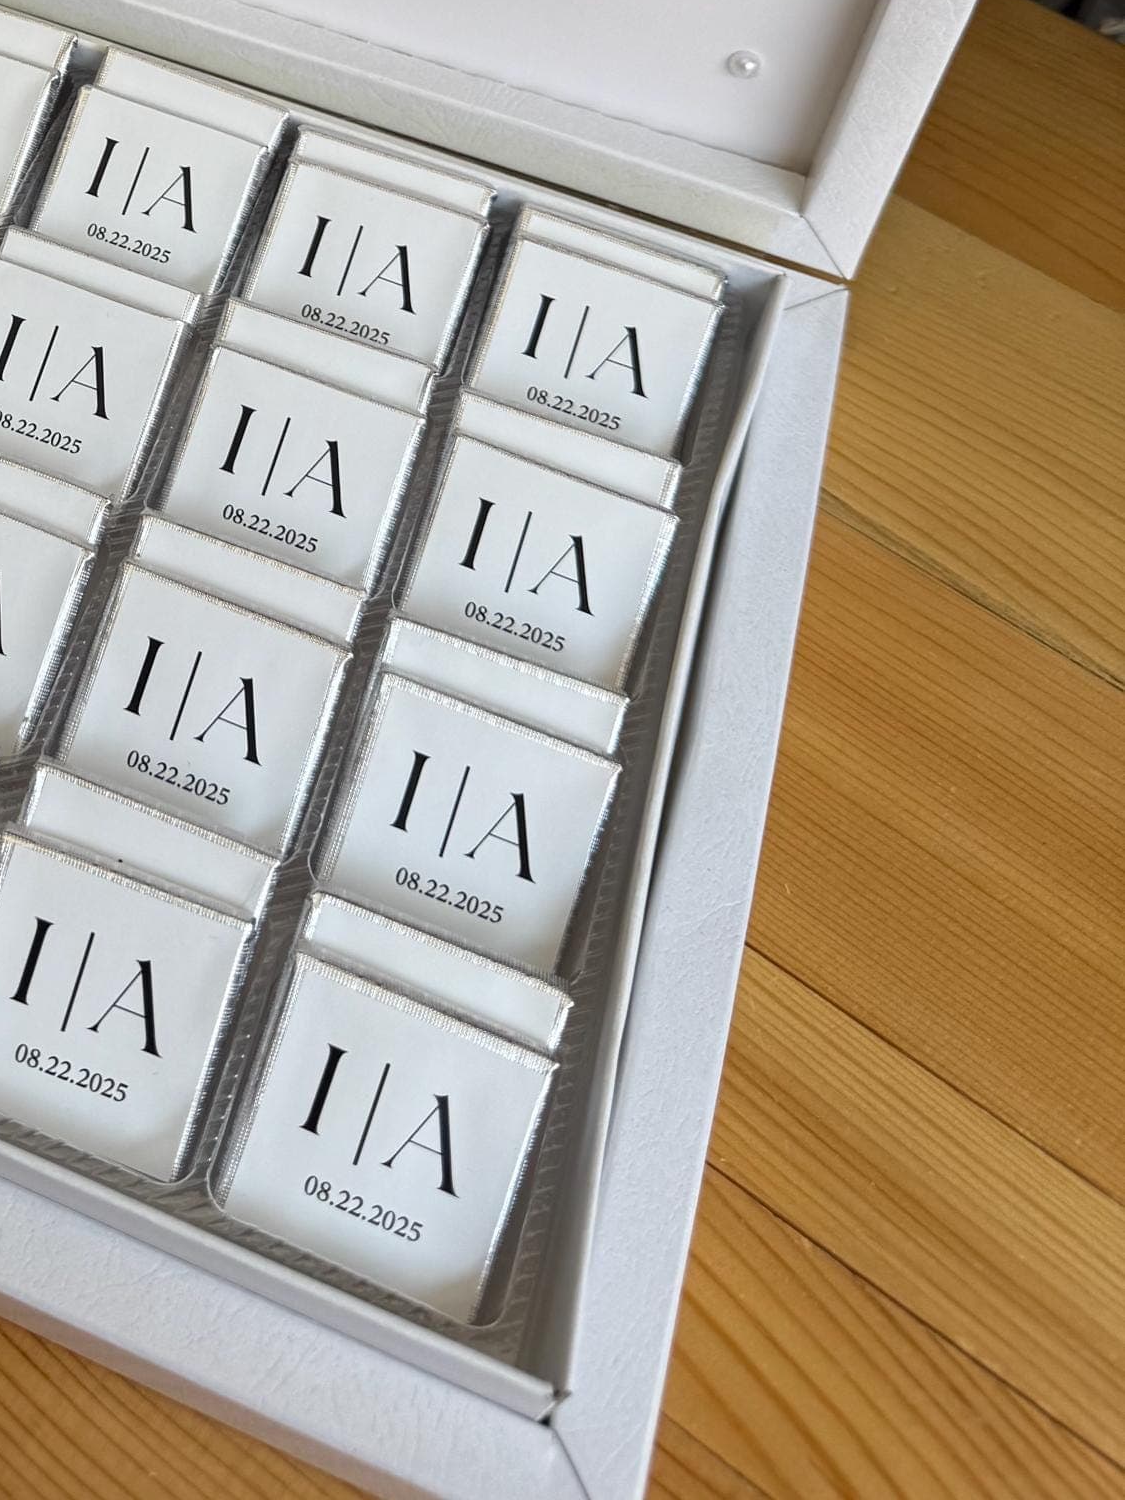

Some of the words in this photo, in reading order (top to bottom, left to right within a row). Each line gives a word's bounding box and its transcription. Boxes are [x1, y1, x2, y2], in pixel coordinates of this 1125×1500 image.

[86, 223, 171, 264] 08.22.2025
[301, 304, 390, 345] 08.22.2025
[527, 387, 621, 430] 08.22.2025
[223, 504, 318, 553] 08.22.2025
[465, 602, 565, 651] 08.22.2025
[127, 751, 230, 805] 08.22.2025
[396, 868, 503, 923] 08.22.2025
[15, 1044, 128, 1101] 08.22.2025
[305, 1176, 423, 1241] 08.22.2025
